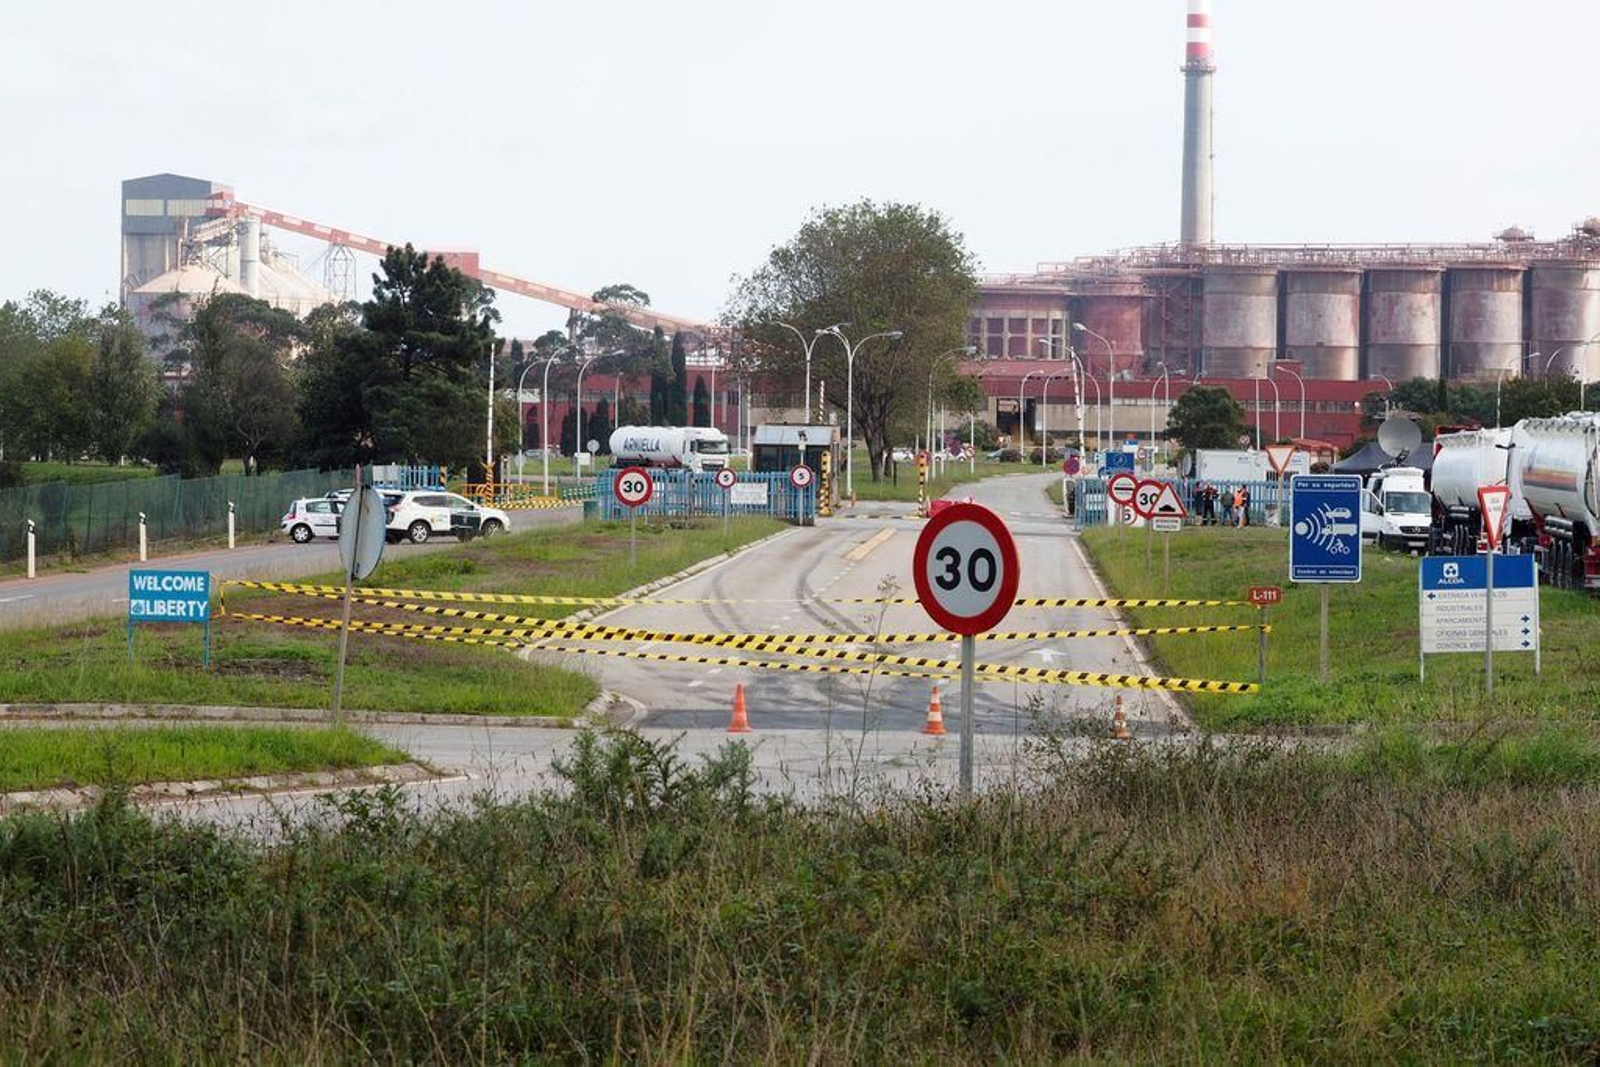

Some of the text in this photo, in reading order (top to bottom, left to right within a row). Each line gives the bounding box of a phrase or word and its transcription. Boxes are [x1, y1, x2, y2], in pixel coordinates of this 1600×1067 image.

[622, 479, 645, 493] 30
[935, 546, 997, 592] 30
[133, 575, 205, 592] WELCOME
[1253, 589, 1277, 600] L-111
[146, 600, 209, 617] LIBERTY
